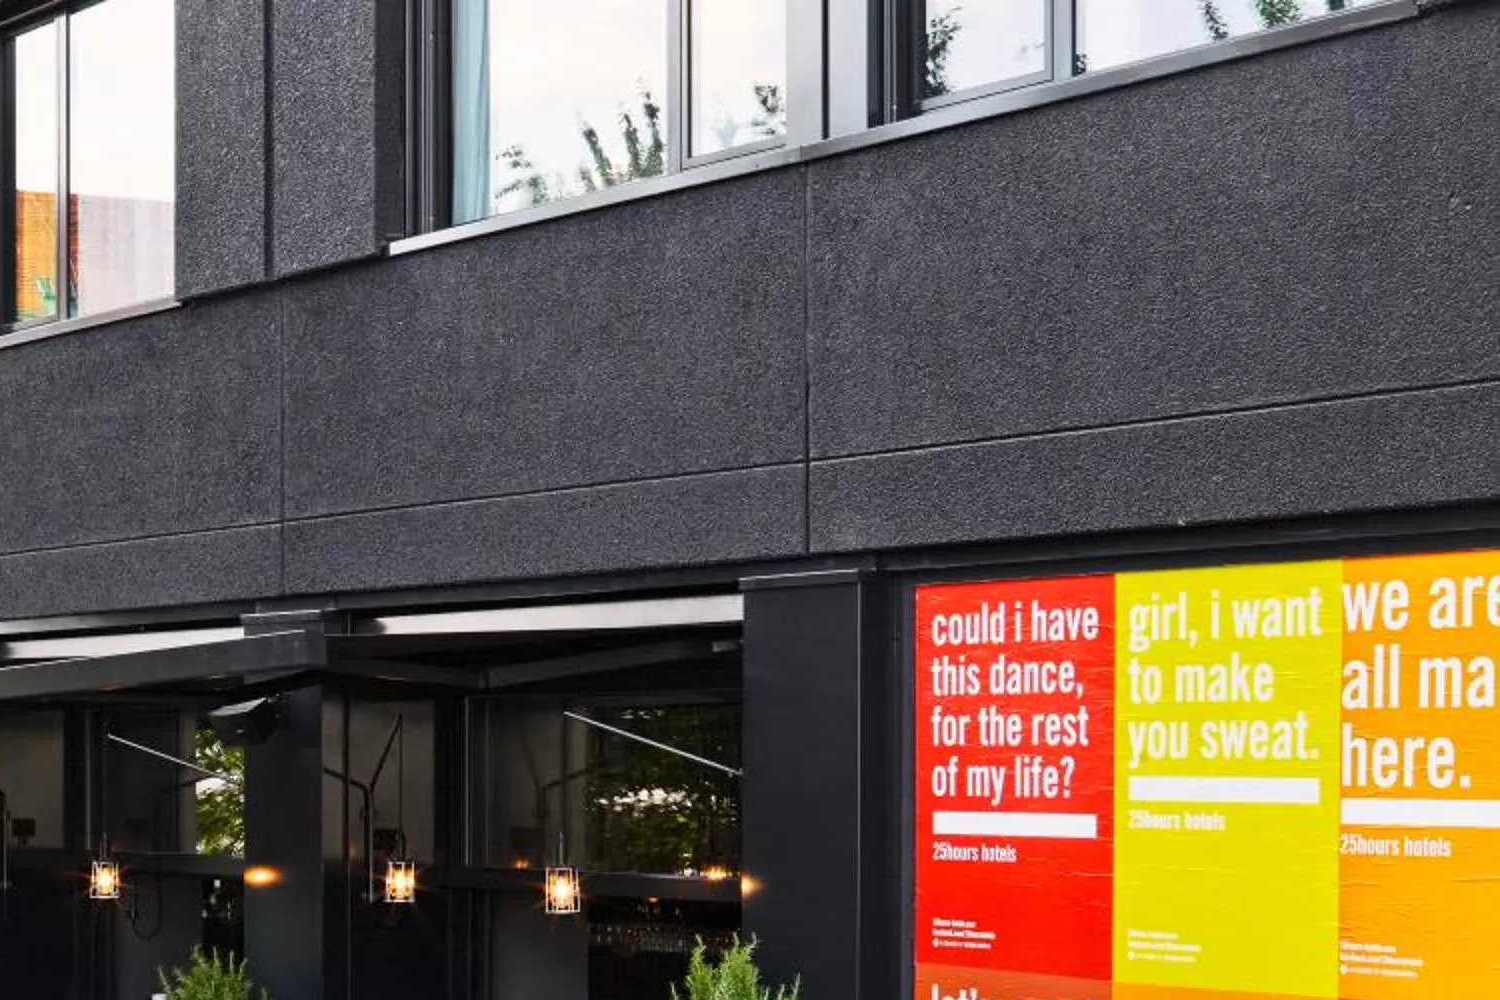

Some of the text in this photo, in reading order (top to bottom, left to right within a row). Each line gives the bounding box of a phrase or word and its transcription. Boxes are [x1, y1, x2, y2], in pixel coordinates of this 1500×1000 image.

[932, 600, 1099, 646] could i have
[1129, 588, 1321, 652] girl, i want
[1342, 580, 1409, 631] we
[931, 654, 1084, 698] this dance,
[1129, 653, 1273, 704] to make
[1342, 644, 1400, 709] all
[932, 705, 1090, 746] for the rest
[1129, 711, 1318, 768] you sweat.
[1342, 723, 1470, 788] here.
[932, 756, 1075, 805] of my life?
[1129, 809, 1225, 831] 25hours hotels
[933, 842, 1016, 862] 25hours hotels
[1341, 834, 1450, 856] 25hours hotels
